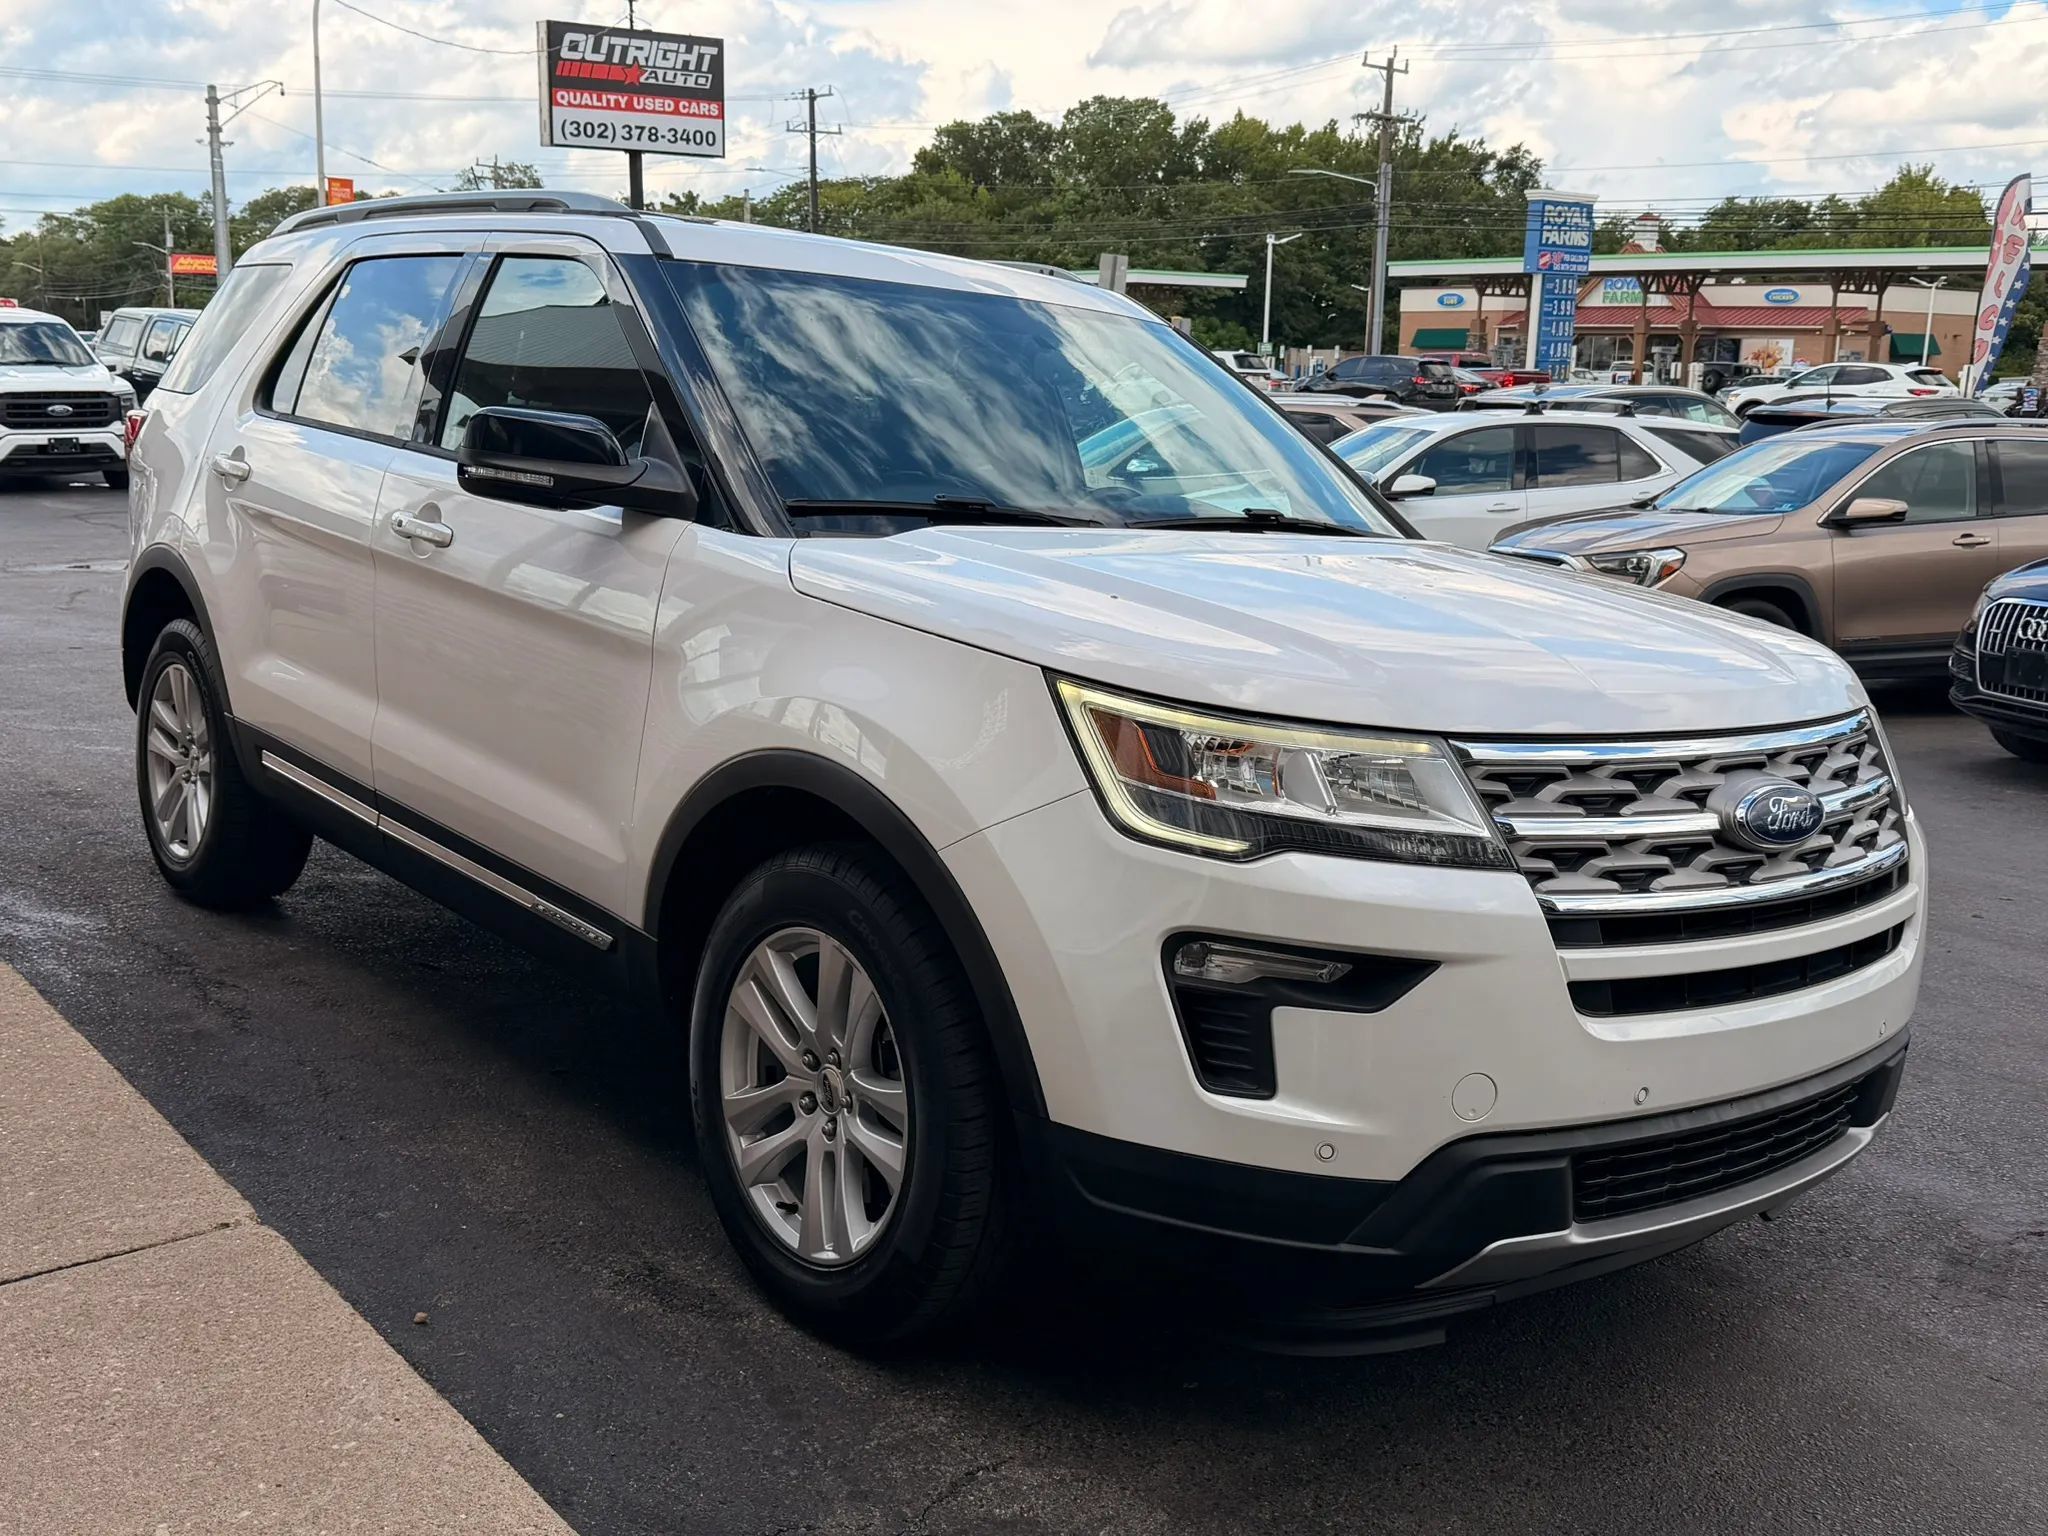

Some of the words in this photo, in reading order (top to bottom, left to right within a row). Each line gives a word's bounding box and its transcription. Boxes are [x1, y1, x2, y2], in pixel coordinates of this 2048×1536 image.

[559, 32, 718, 72] OUTRIGHT
[644, 70, 711, 87] AUTO
[556, 90, 629, 109] QUALITY
[633, 96, 675, 112] USED
[678, 100, 719, 116] CARS
[561, 119, 616, 143] (302)
[621, 124, 717, 147] 378-3400
[1544, 204, 1590, 227] ROYAL
[1541, 225, 1589, 247] FARMS
[1604, 278, 1641, 290] ROYA
[1602, 290, 1645, 304] FARM
[1768, 796, 1815, 832] Ford
